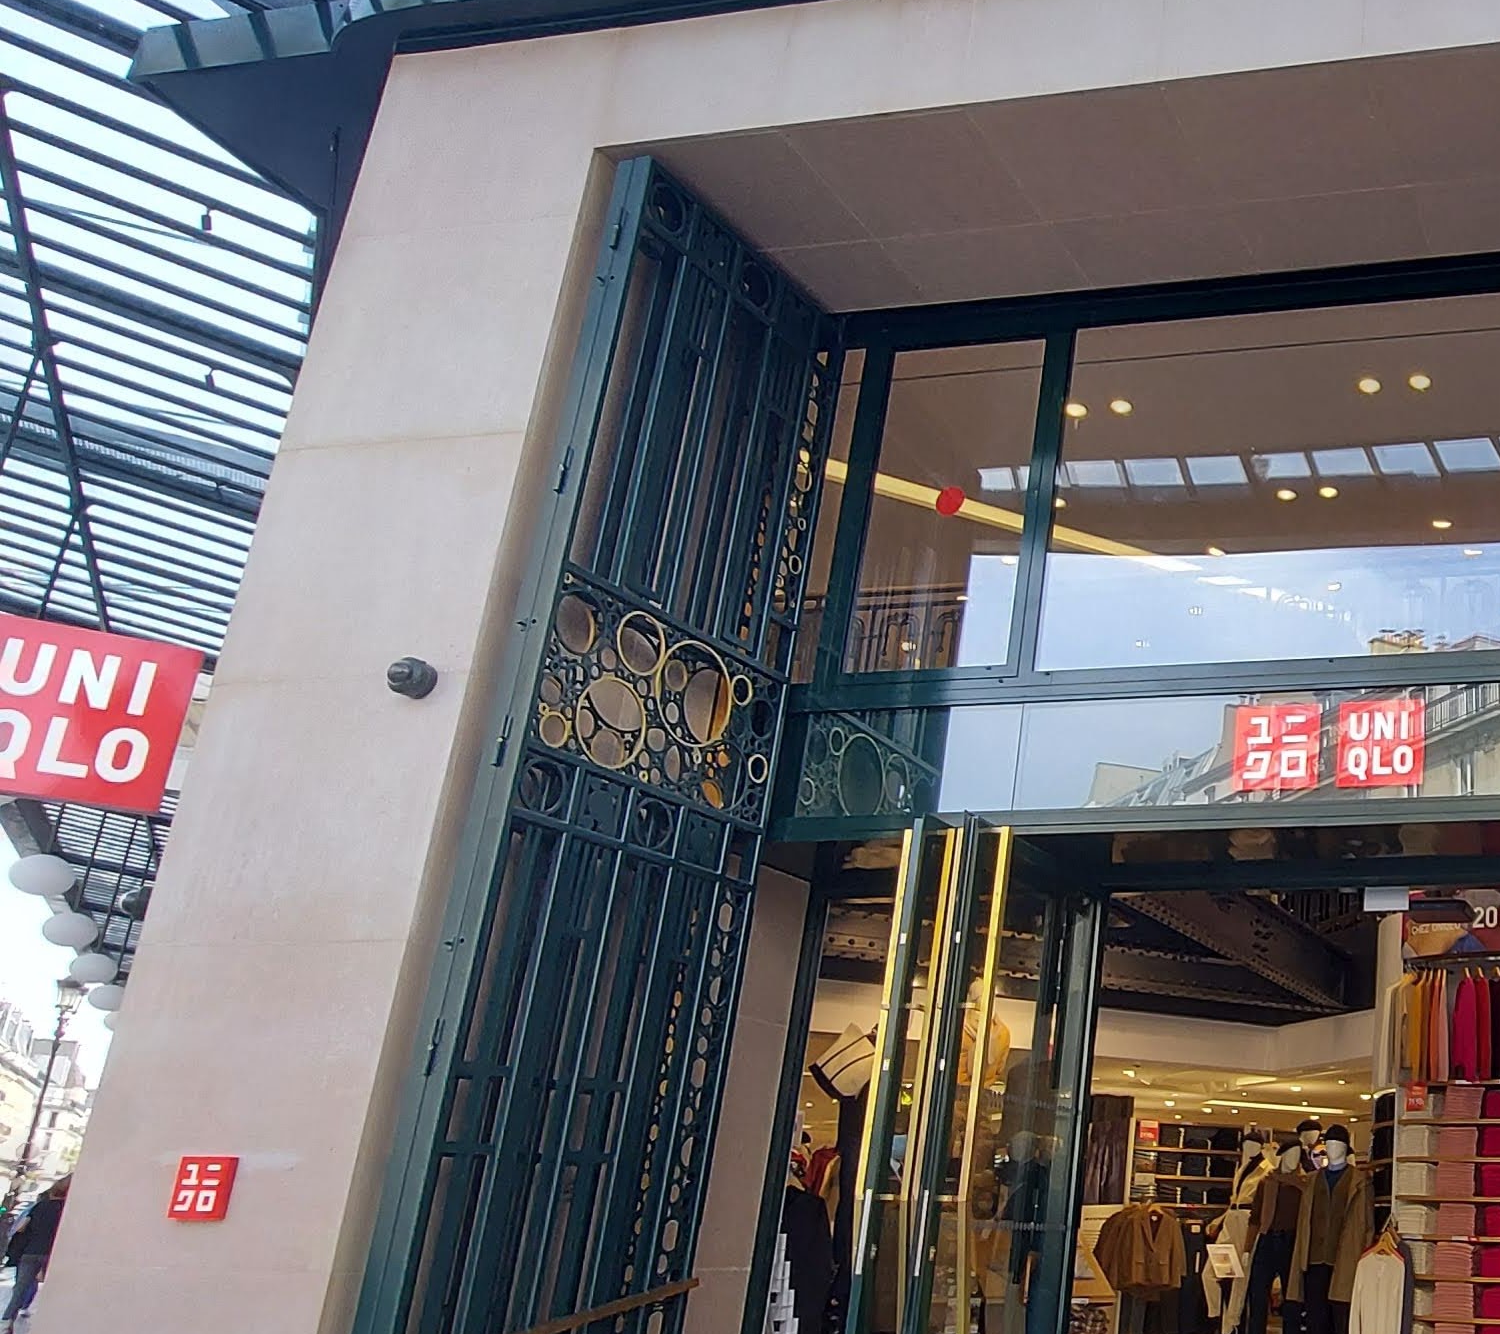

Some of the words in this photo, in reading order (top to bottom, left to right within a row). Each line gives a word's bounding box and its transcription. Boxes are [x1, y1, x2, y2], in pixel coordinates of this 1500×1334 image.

[0, 637, 158, 716] UNI
[1350, 710, 1409, 741] UNI
[0, 708, 150, 783] QLO
[1346, 744, 1414, 781] QLO
[1472, 906, 1498, 928] 20
